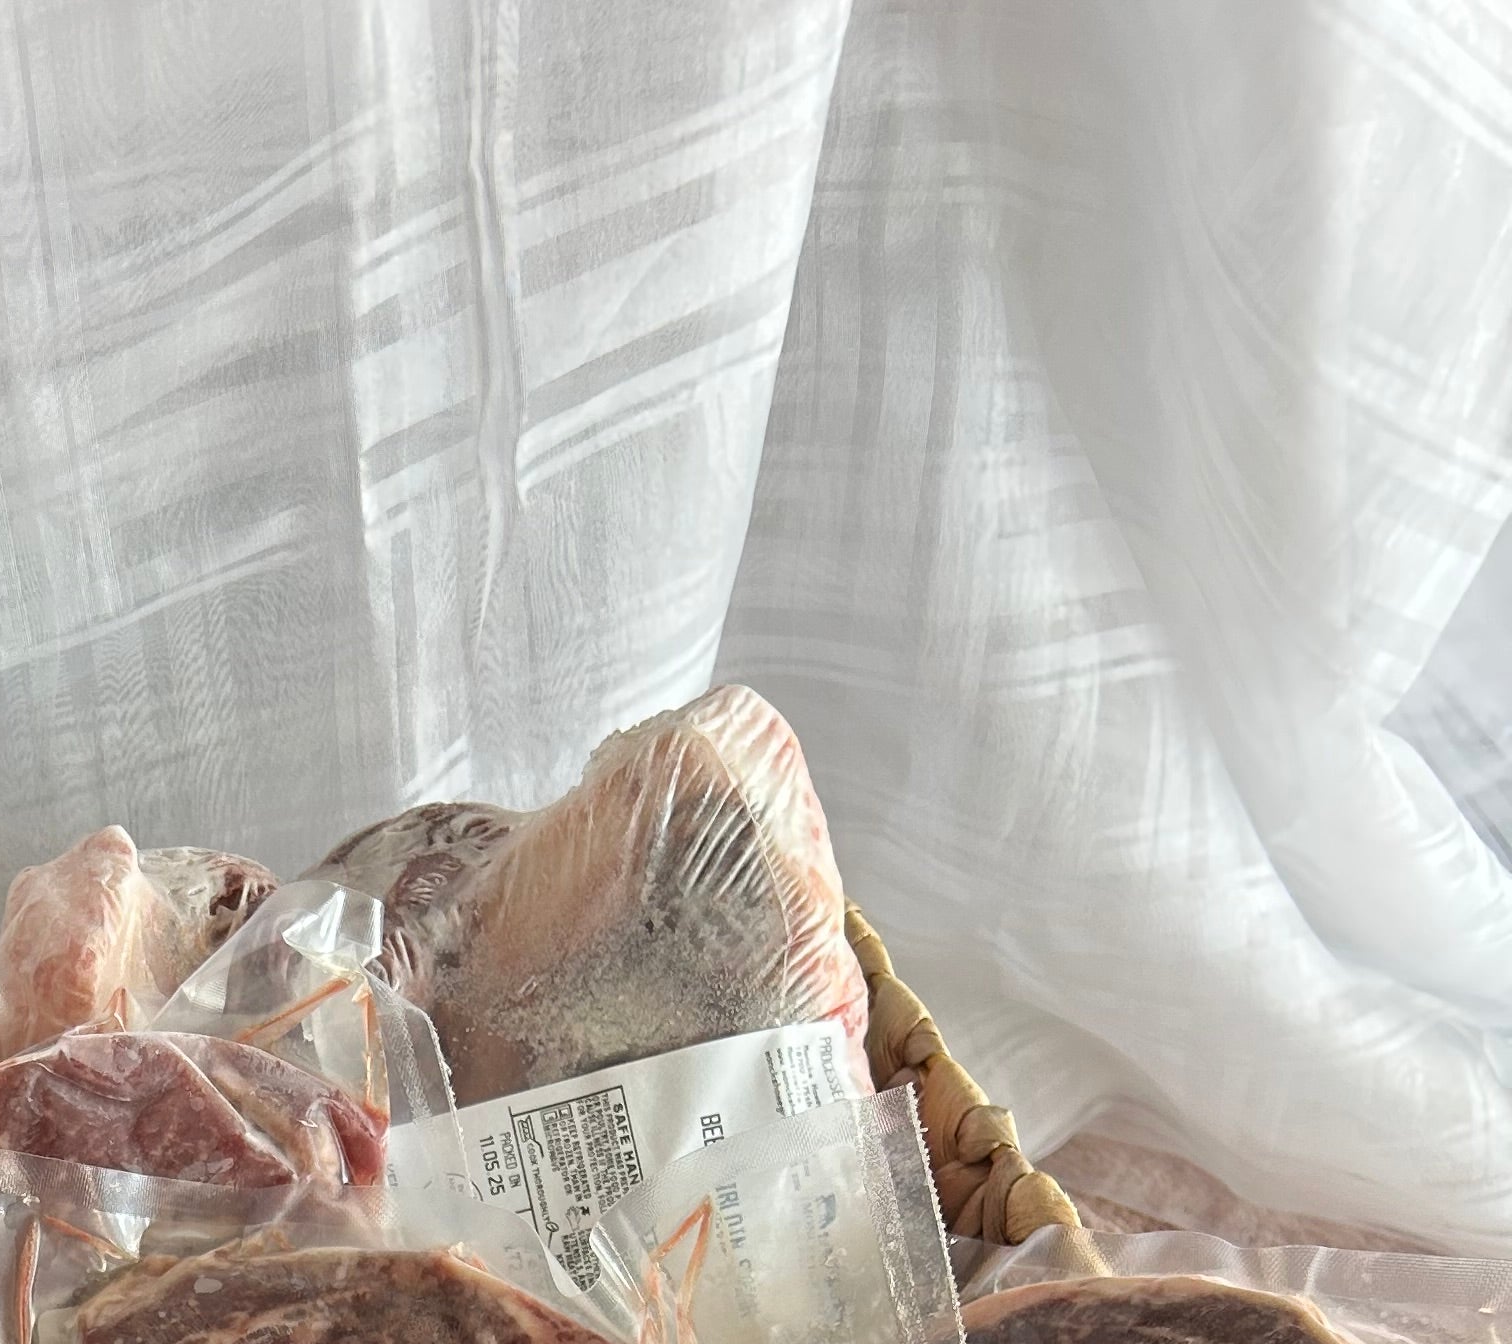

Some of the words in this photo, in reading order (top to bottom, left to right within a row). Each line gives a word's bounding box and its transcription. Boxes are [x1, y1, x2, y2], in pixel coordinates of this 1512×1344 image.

[818, 1035, 846, 1103] PROCESSE
[611, 1102, 631, 1145] SAFE
[478, 1135, 505, 1196] 11.05.25
[498, 1131, 518, 1169] PACKED
[507, 1173, 522, 1188] ON
